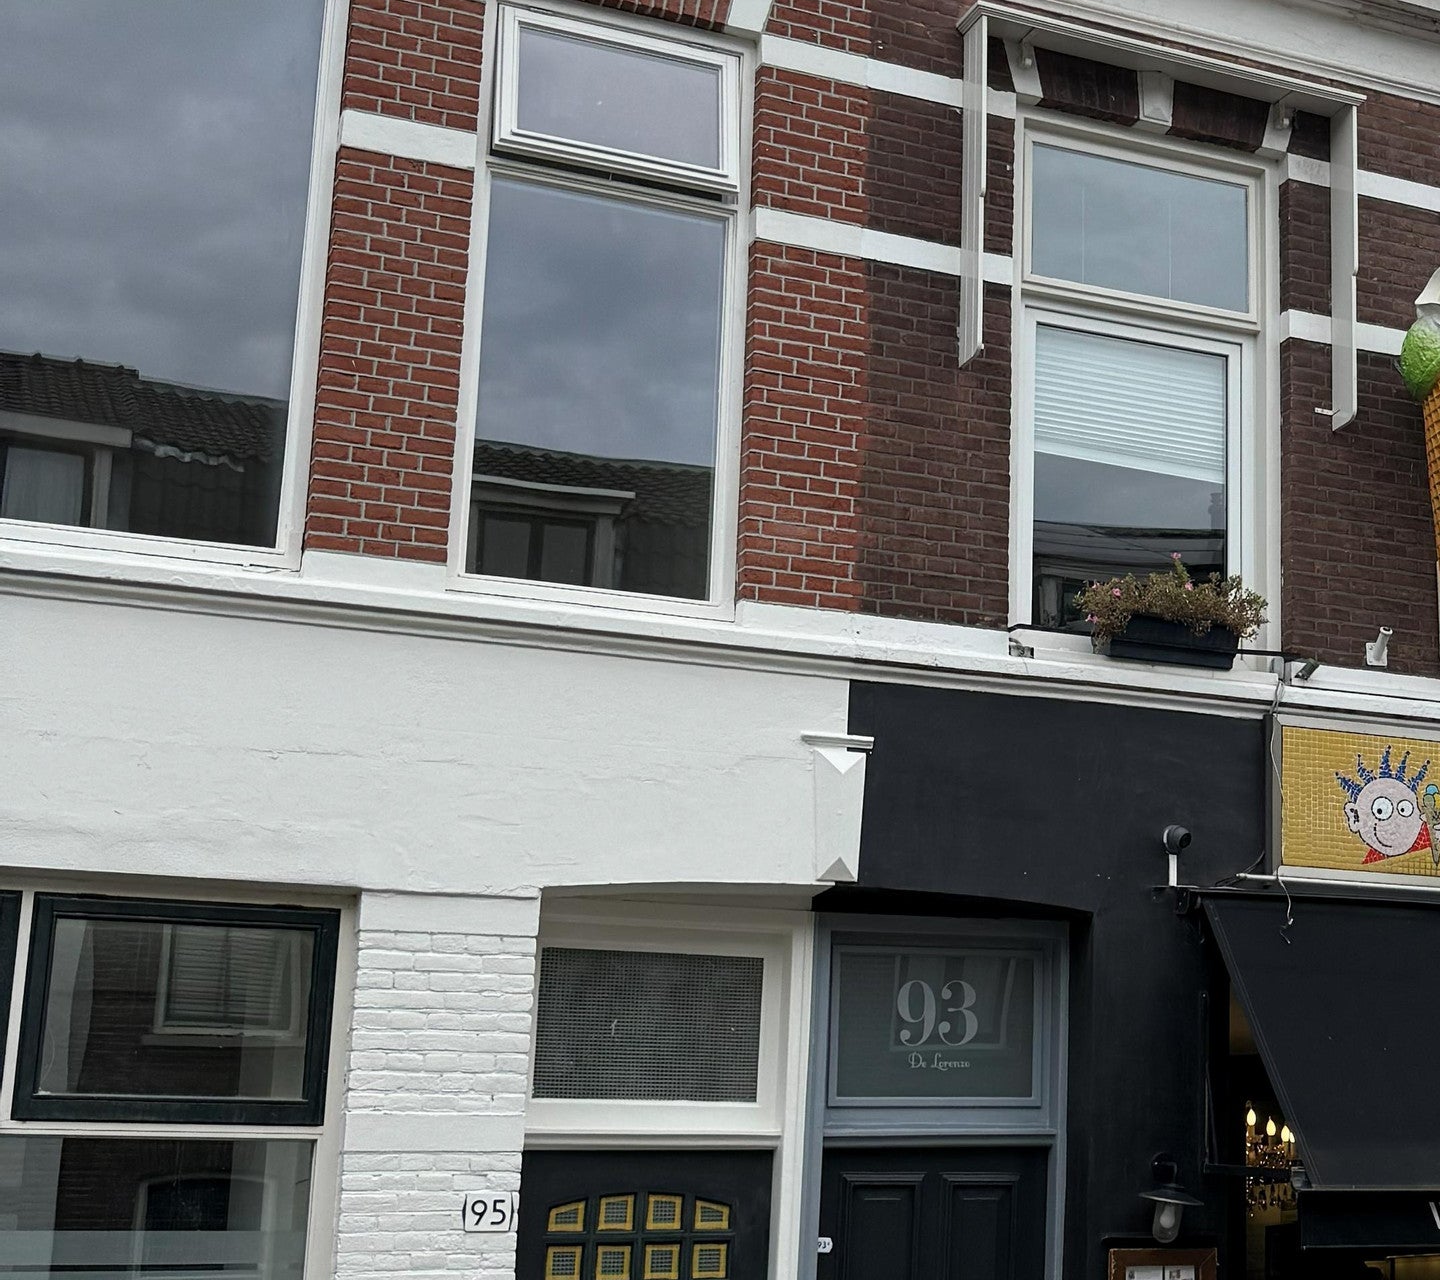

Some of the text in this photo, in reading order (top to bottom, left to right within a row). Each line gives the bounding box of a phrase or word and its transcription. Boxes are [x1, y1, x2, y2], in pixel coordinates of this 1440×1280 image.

[896, 979, 979, 1047] 93
[908, 1051, 971, 1071] De Lorenzo
[470, 1199, 507, 1226] 95
